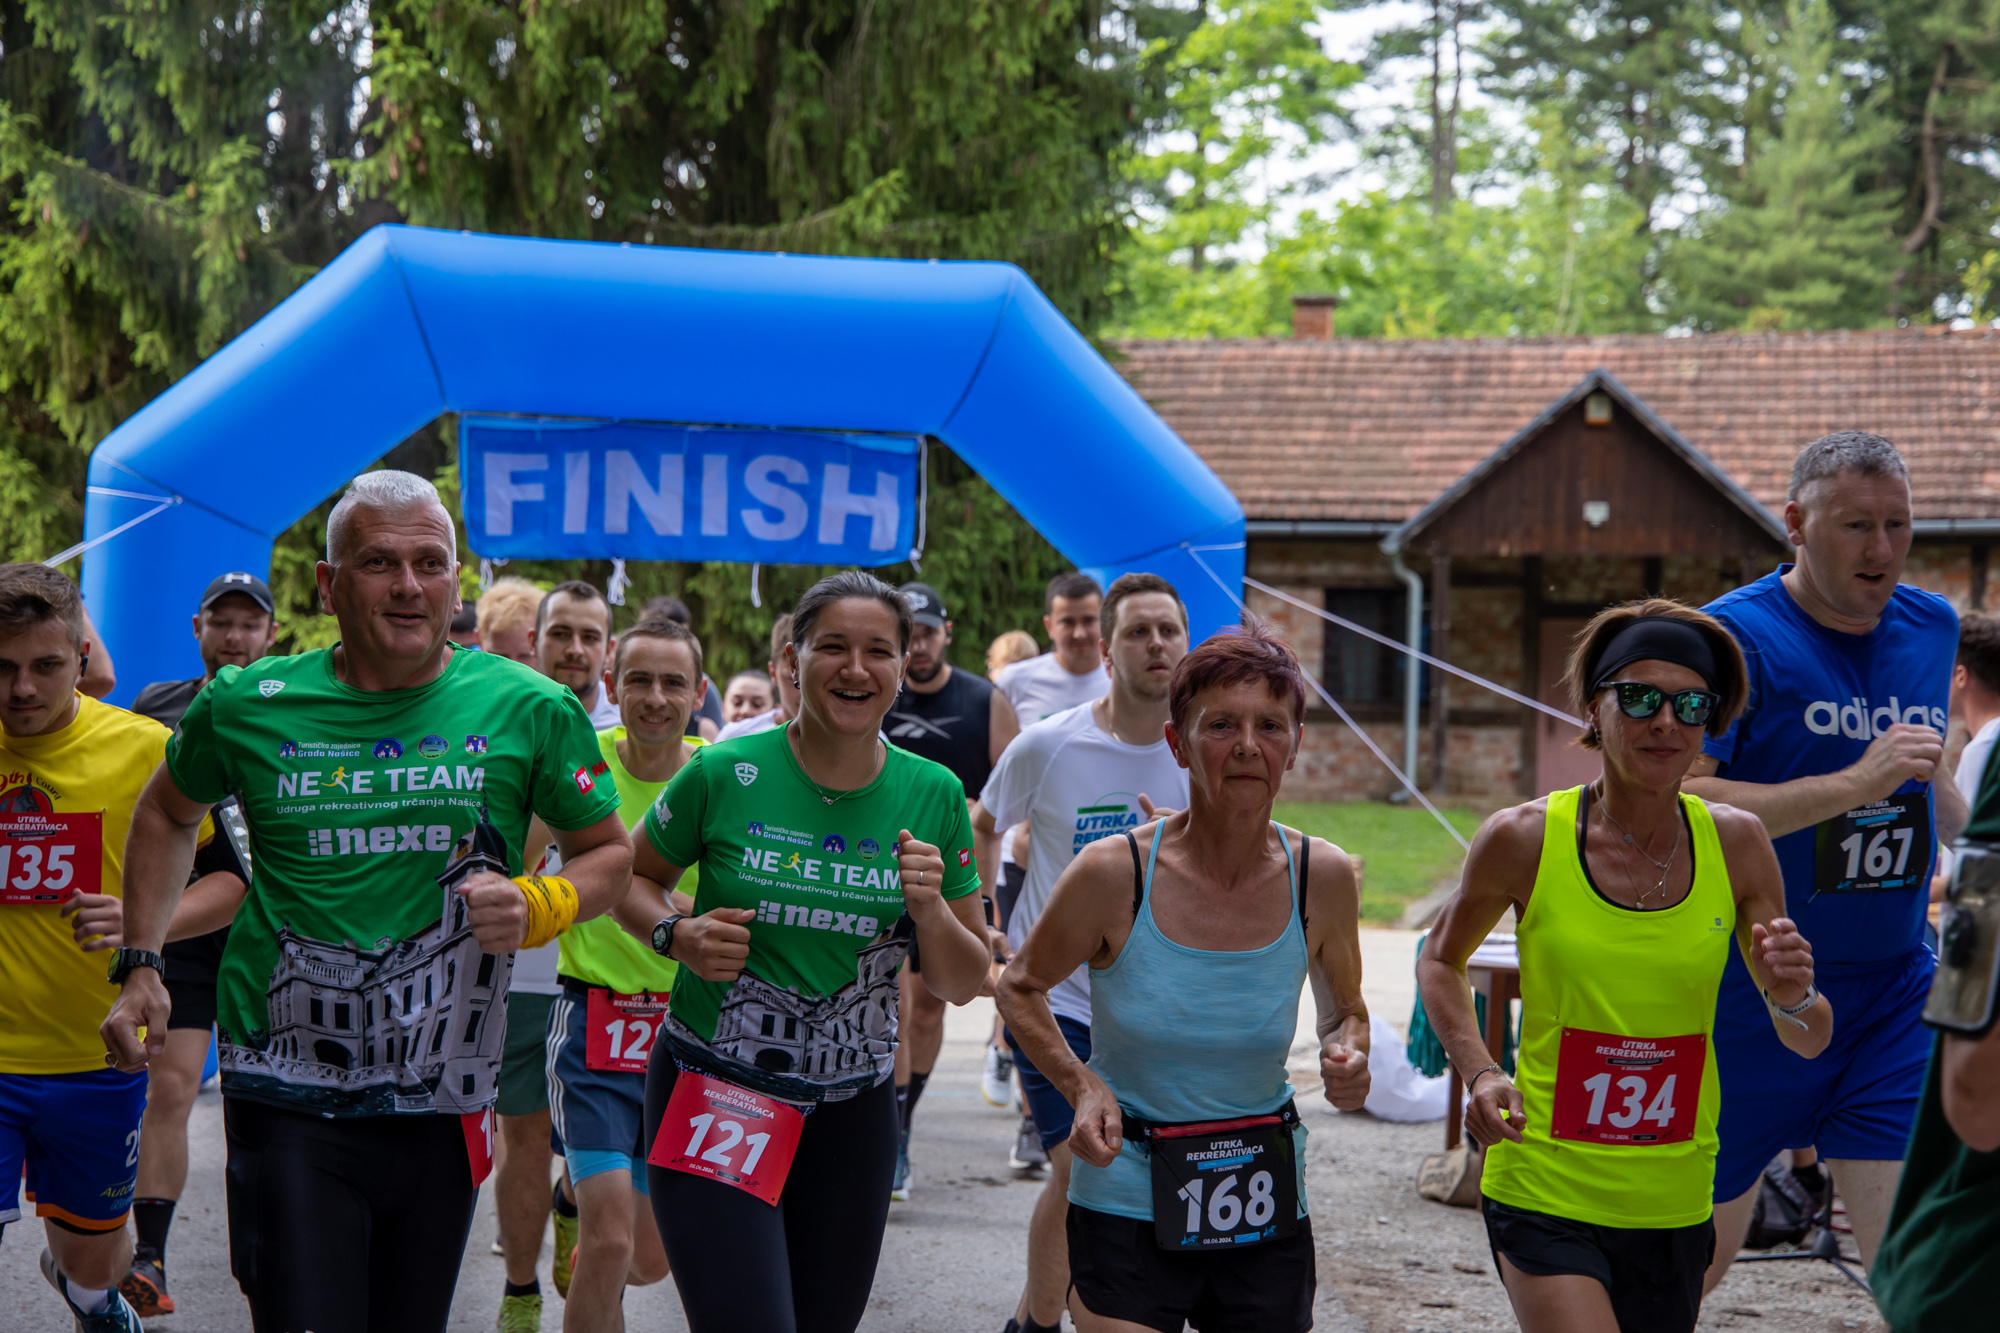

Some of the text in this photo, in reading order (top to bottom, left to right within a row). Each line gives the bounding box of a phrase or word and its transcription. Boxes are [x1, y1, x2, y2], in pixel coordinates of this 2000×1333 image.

[484, 450, 899, 552] FINISH
[1804, 696, 1947, 740] adidas
[384, 765, 485, 792] TEAM
[276, 797, 481, 814] Udruga rekreativnog trčanja Našice
[1076, 813, 1138, 831] UTRKA
[336, 825, 451, 855] nexe
[763, 831, 813, 847] Grada Našice
[1840, 827, 1914, 878] 167
[0, 845, 76, 890] 135
[830, 863, 902, 890] TEAM
[738, 871, 905, 904] Udruga rekreativnog trčanja Našice
[784, 902, 879, 937] nexe
[605, 1019, 663, 1060] 12
[1596, 1046, 1675, 1058] REKRERATIVACA
[1622, 1040, 1656, 1050] UTRKA
[703, 1089, 775, 1119] REKRERATIVACA
[727, 1089, 757, 1105] UTRKA
[1583, 1072, 1677, 1129] 134
[684, 1112, 772, 1176] 121
[1186, 1145, 1264, 1161] REKRERATIVACA
[1210, 1139, 1243, 1150] UTRKA
[1177, 1170, 1275, 1232] 168
[1203, 1236, 1232, 1244] 08.06.2024.
